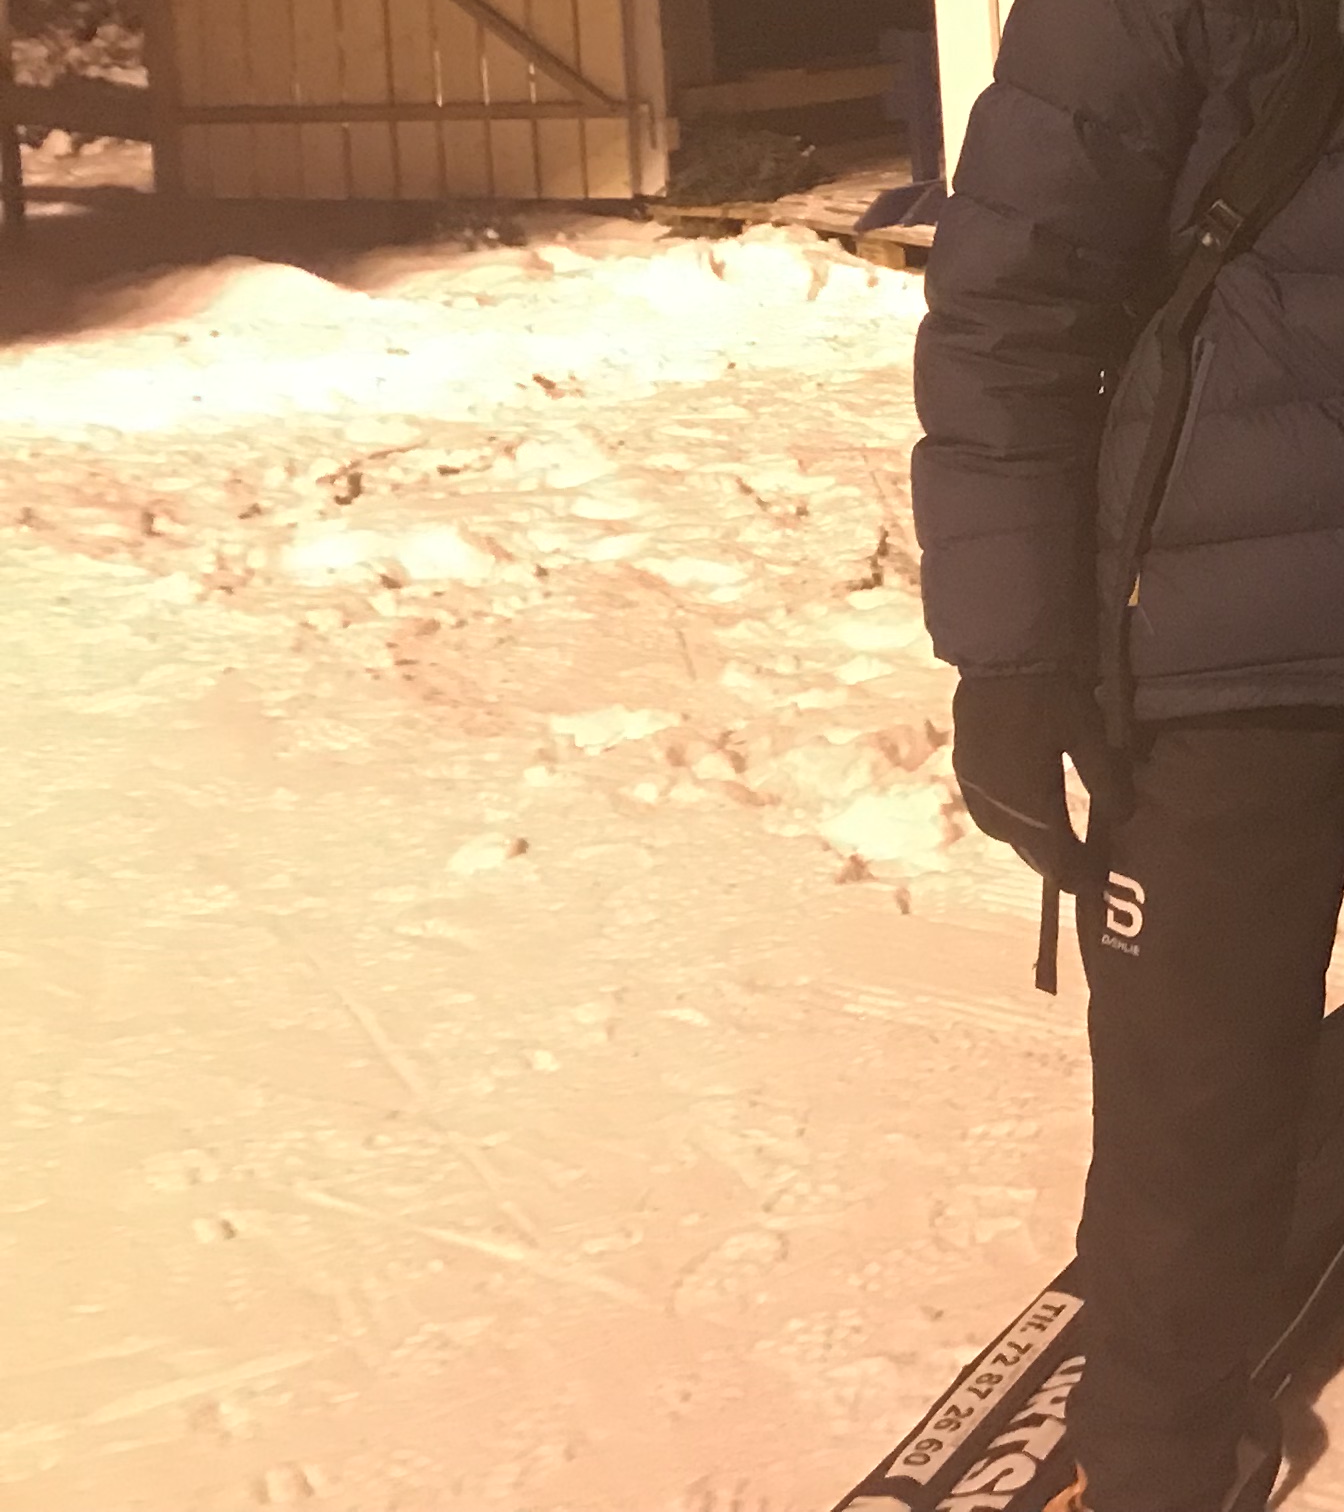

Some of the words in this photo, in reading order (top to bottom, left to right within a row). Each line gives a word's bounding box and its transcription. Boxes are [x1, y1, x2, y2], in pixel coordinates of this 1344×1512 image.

[1020, 1304, 1067, 1332] Tlf.
[991, 1341, 1033, 1366] 72
[967, 1372, 1003, 1400] 87
[933, 1404, 974, 1432] 26
[903, 1438, 943, 1466] 60
